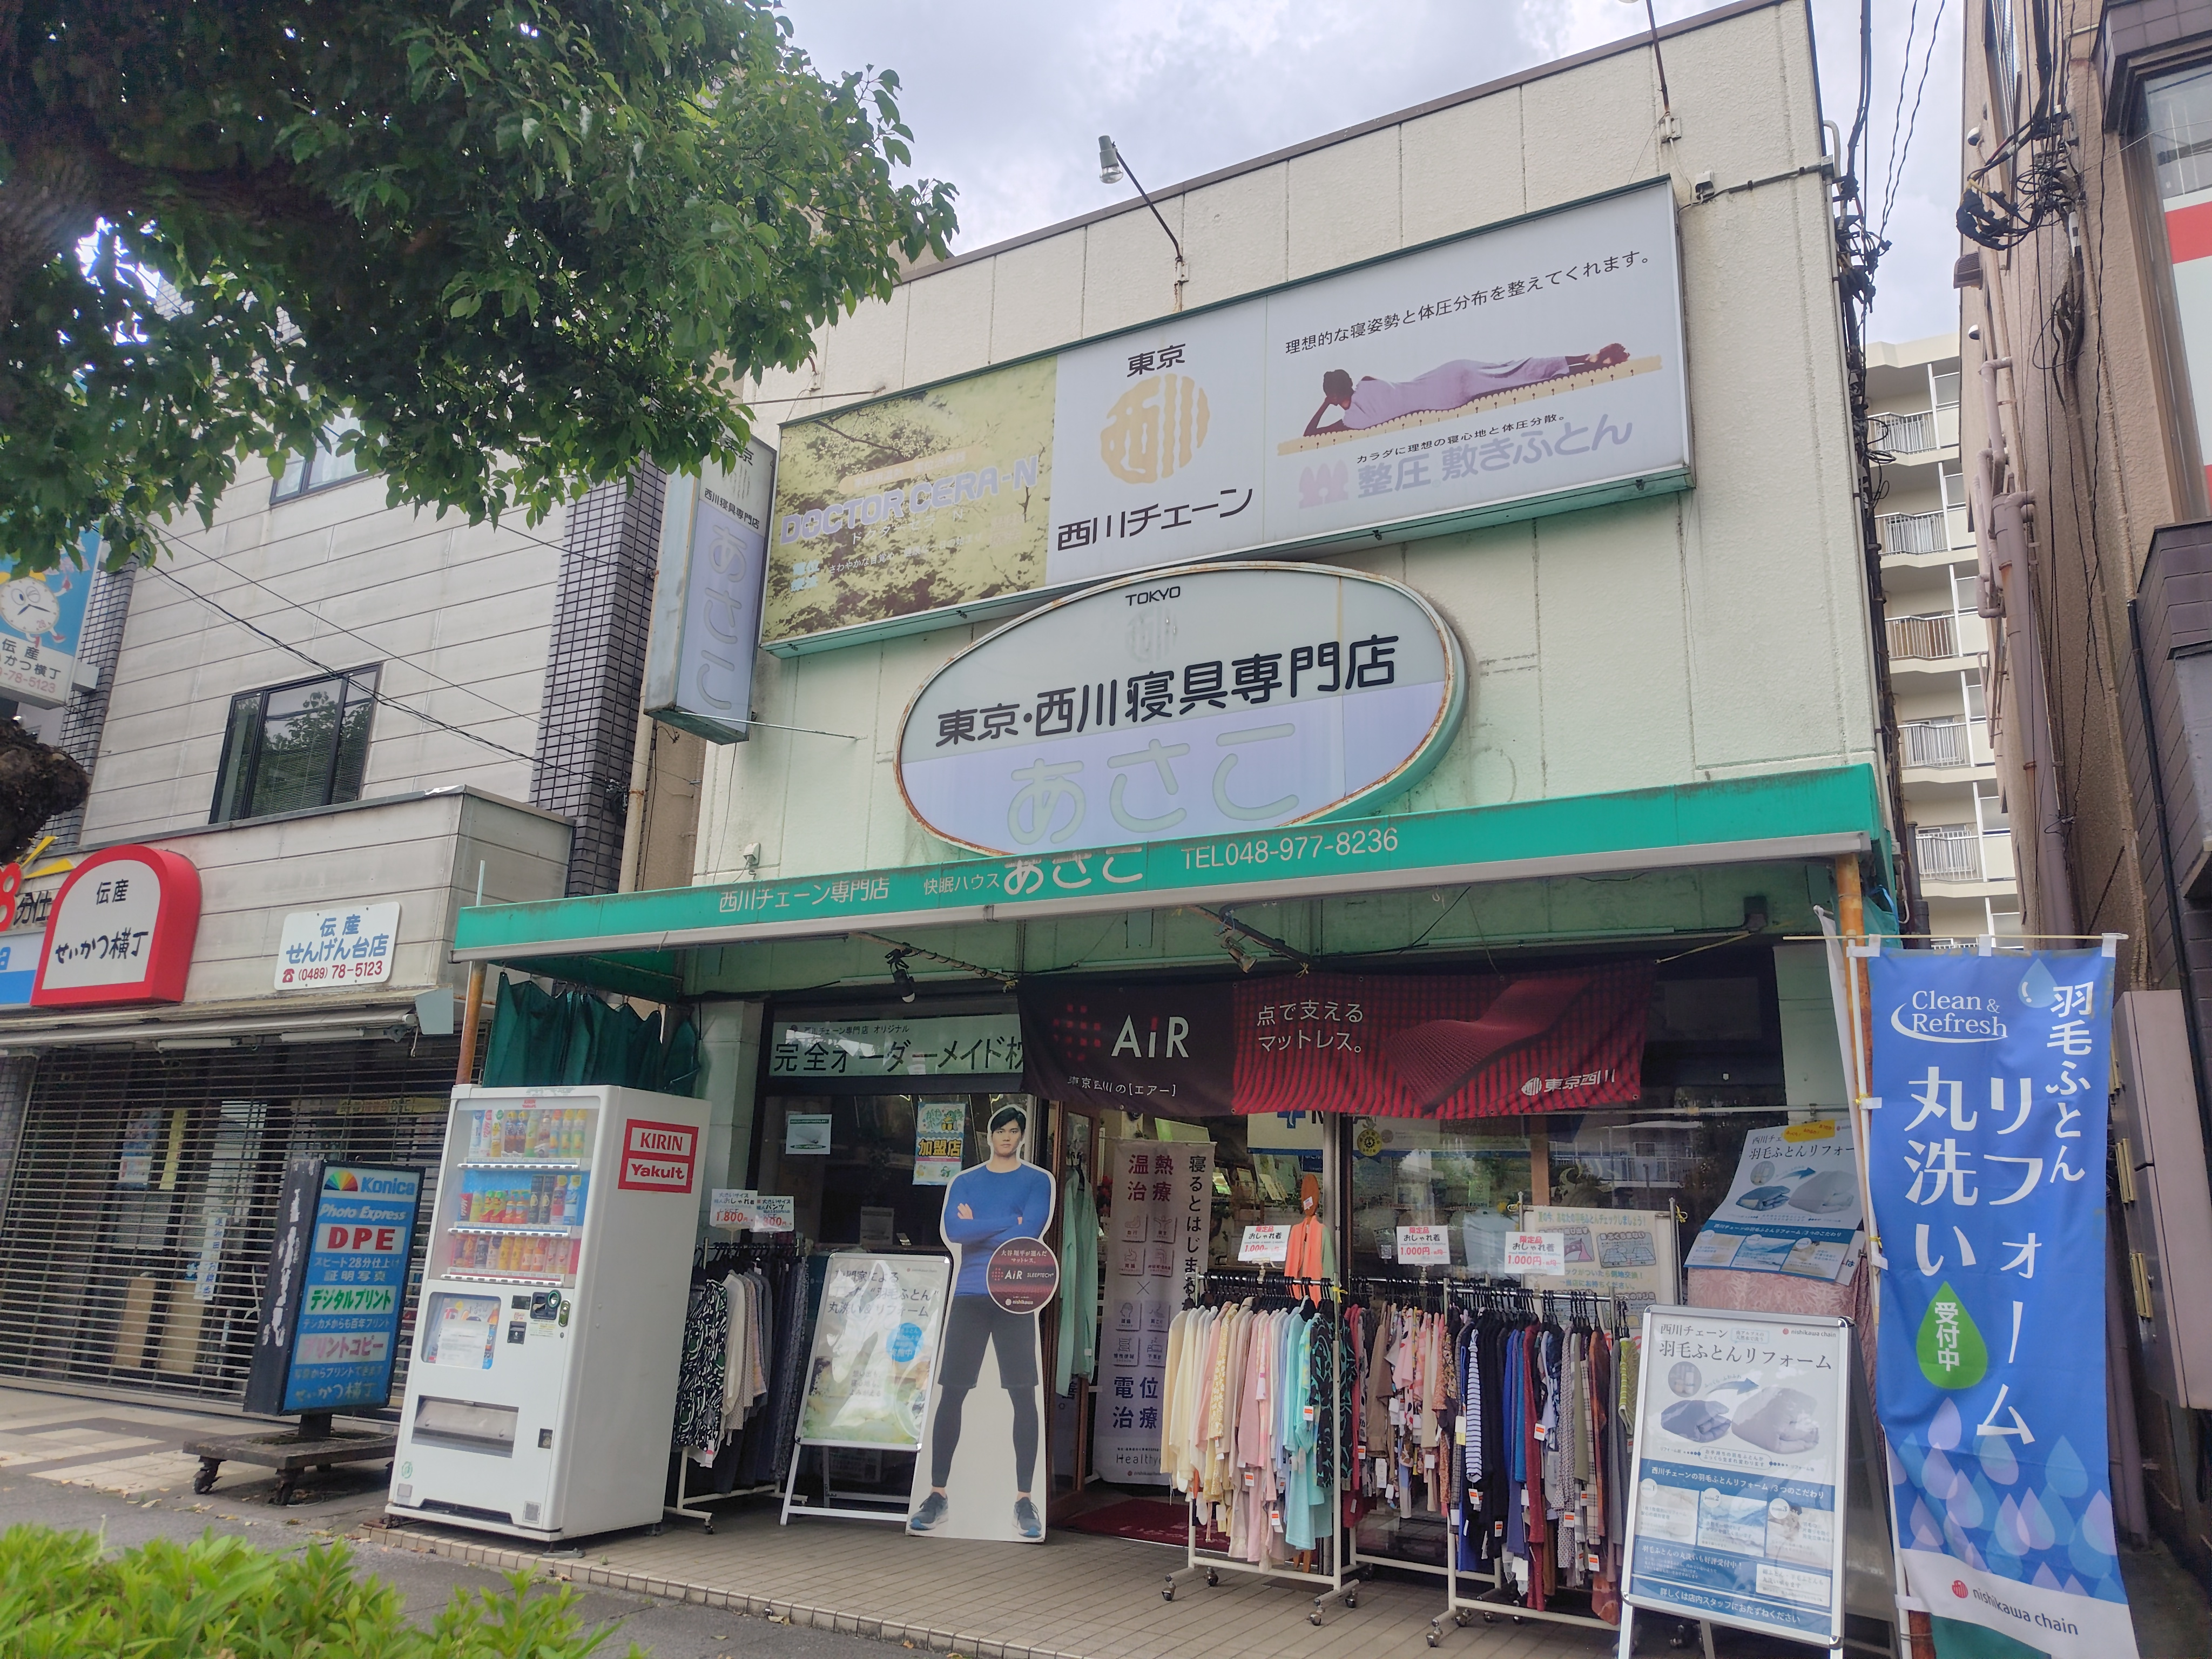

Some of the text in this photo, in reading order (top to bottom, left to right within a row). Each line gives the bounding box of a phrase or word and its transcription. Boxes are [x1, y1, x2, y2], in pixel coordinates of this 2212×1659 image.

[1285, 250, 1649, 355] 理想的な寝姿勢と体圧分布を整えてくれます。
[1128, 344, 1185, 377] 東京
[1357, 416, 1565, 463] カラダに理想の寝心地と体圧分散。
[704, 488, 760, 530] 西川寝具専門店
[780, 455, 1039, 545] DOCTOR CERA-N
[1058, 488, 1252, 551] 西川チェーン
[829, 550, 894, 574] さわやかな目覚め
[1125, 586, 1181, 607] TOKYO
[697, 524, 747, 710] あさこ
[2, 638, 40, 662] 伝産
[0, 655, 62, 680] かつ横丁
[936, 633, 1399, 748] 東京・西川寝具専門店
[1007, 721, 1300, 846] あさこ
[719, 878, 890, 913] 西川チェーン専門店
[923, 873, 1000, 896] 快眠ハウス
[1003, 846, 1143, 895] あさこ
[96, 879, 129, 905] 伝産
[320, 914, 360, 937] 伝産
[55, 927, 149, 964] せいかつ横丁
[286, 934, 389, 964] せんげん台店
[332, 960, 382, 979] 78-5123
[1257, 999, 1363, 1026] 点で支える
[1912, 990, 2000, 1013] Clean &
[873, 1025, 909, 1033] オリジナル
[1913, 1013, 2007, 1038] Refresh
[1258, 1029, 1361, 1053] マットレス。
[1544, 1069, 1615, 1092] 東京西川
[2046, 981, 2094, 1183] 羽毛ふとん
[640, 1132, 683, 1151] KIRIN
[919, 1139, 961, 1156] 加盟店
[631, 1164, 684, 1179] Yakult
[1904, 1066, 1978, 1276] 丸洗い
[361, 1177, 415, 1195] Konica
[319, 1204, 406, 1221] Photo Express
[327, 1227, 395, 1250] DPE
[1513, 1243, 1555, 1252] おしゃれ着
[1520, 1236, 1542, 1244] 限定品
[1977, 1077, 2043, 1445] リフォーム
[324, 1271, 385, 1282] 証明写真
[311, 1288, 391, 1311] デジタルプリント
[1660, 1324, 1728, 1338] 西川チェーン
[1935, 1301, 1960, 1372] 受付中
[302, 1335, 383, 1359] プリントコピー
[1660, 1340, 1831, 1370] 羽毛ふとんリフォーム
[1116, 1454, 1161, 1466] Healthy
[1651, 1467, 1768, 1491] 西川チェーンの羽毛ふとんリフォーム
[1660, 1587, 1800, 1623] 詳しくは店内スタッフにおたずねください
[1973, 1587, 2079, 1636] nishikawa chain
